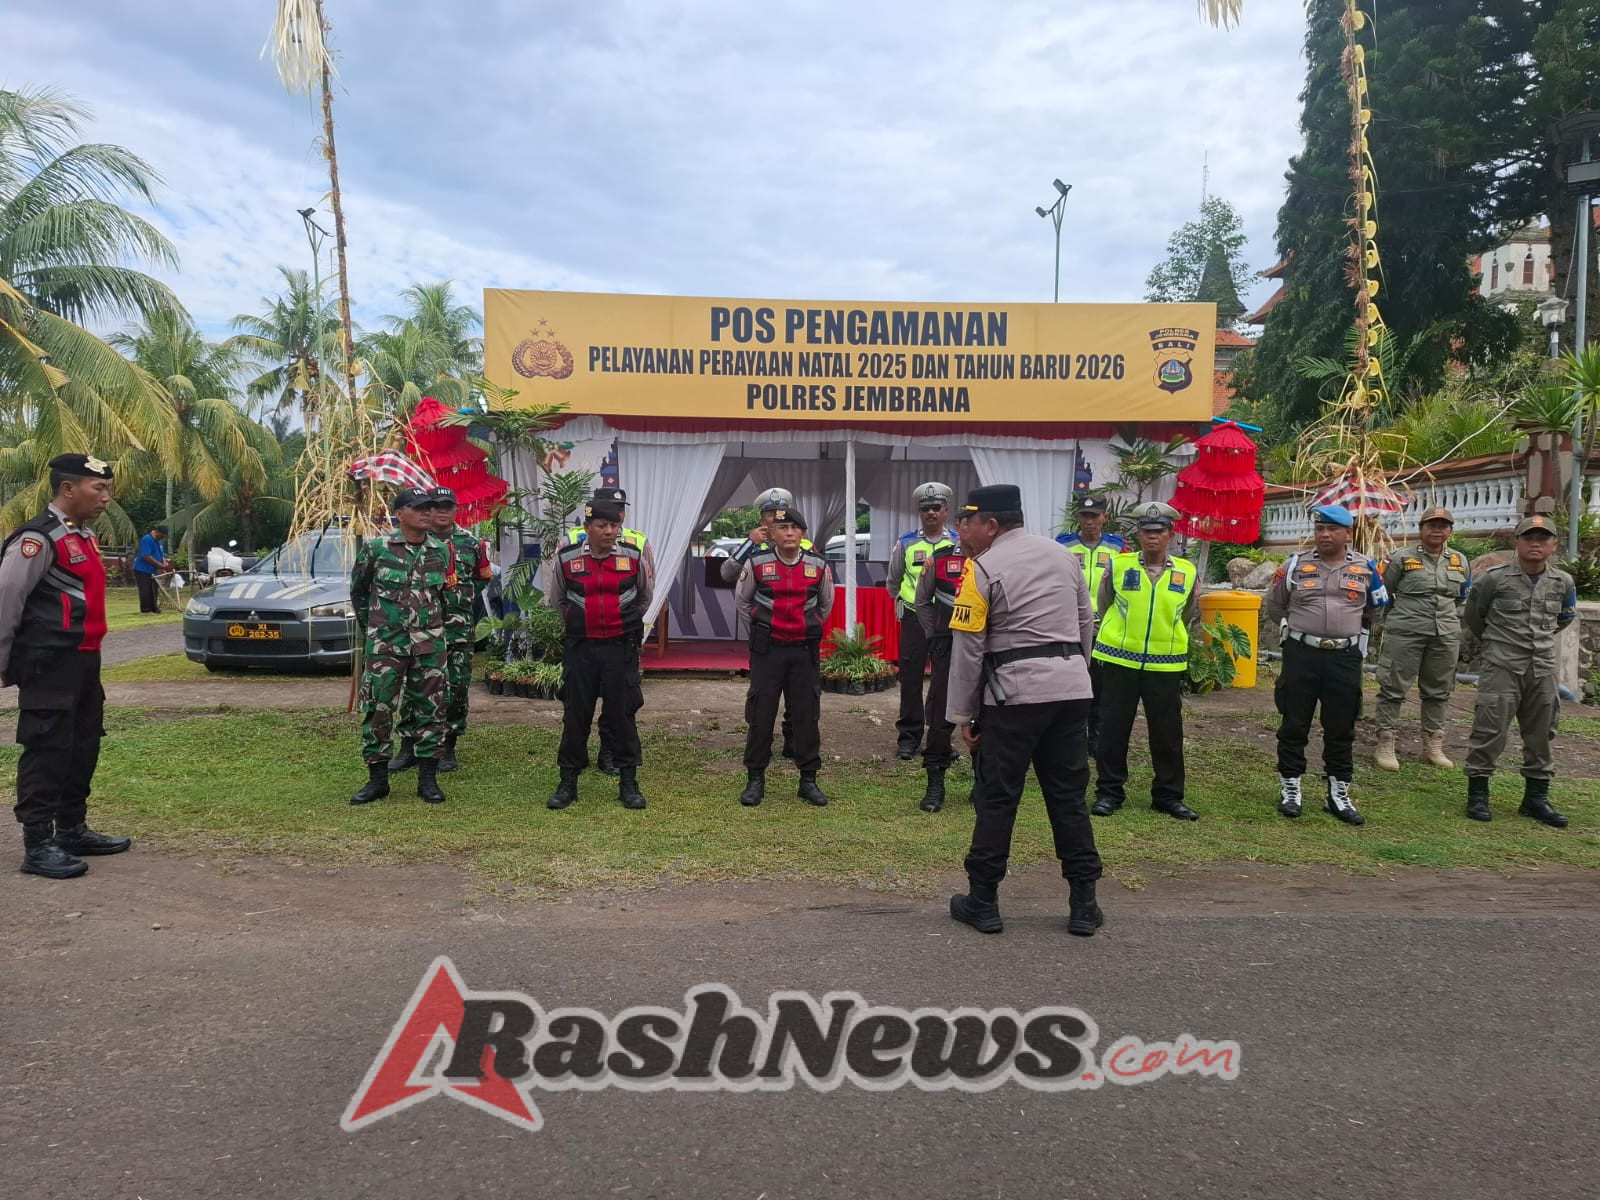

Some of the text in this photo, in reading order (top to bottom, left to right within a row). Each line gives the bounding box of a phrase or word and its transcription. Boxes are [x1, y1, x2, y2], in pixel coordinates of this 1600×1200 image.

[710, 306, 1008, 347] POS PENGAMANAN
[1157, 341, 1190, 349] BALI
[588, 345, 1125, 380] PELAYANAN PERAYAAN NATAL 2025 DAN TAHUN BARU 2026
[746, 383, 971, 413] POLRES JEMBRANA
[955, 607, 971, 624] PAM
